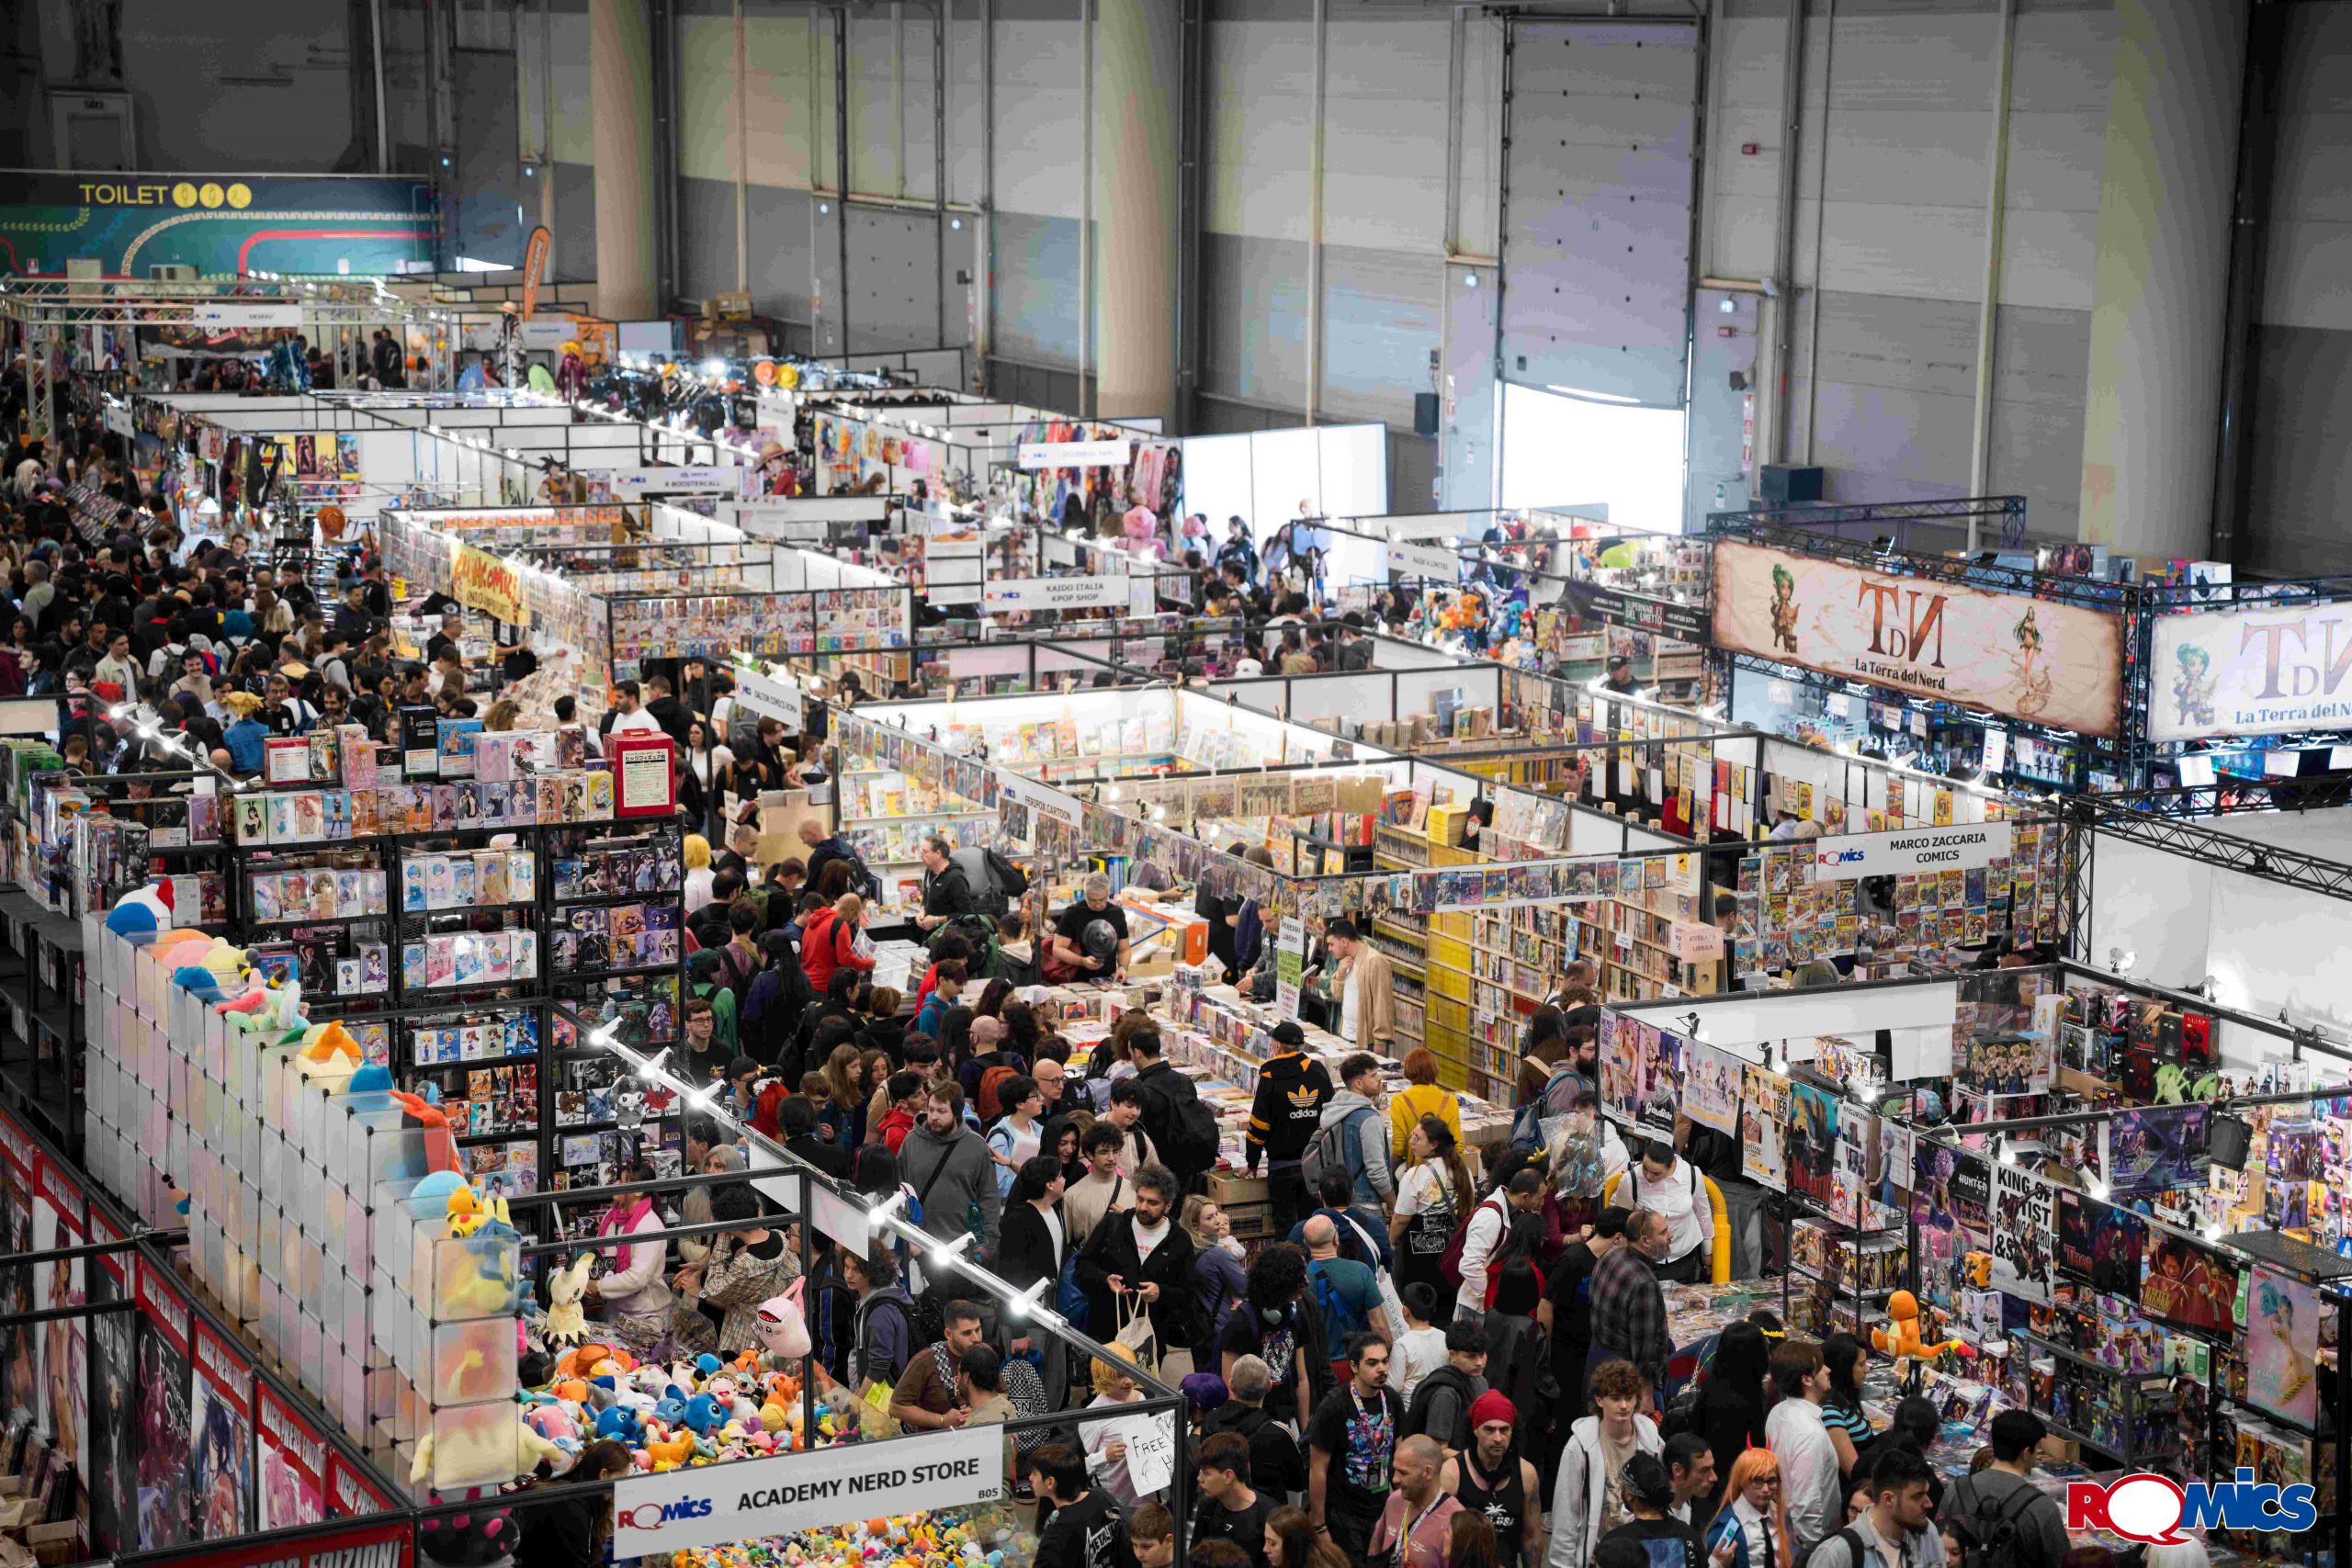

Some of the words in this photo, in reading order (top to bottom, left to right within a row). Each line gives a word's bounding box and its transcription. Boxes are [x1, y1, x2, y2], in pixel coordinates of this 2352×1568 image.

[79, 184, 168, 205] TOILET
[1046, 584, 1073, 592] KAIDO
[1052, 594, 1073, 603] KPOP
[1855, 659, 1867, 672] La
[1869, 661, 1899, 682] Terra
[1901, 670, 1917, 684] del
[1919, 672, 1945, 690] Nerd
[2235, 711, 2255, 724] La
[2258, 708, 2307, 722] Terra
[2312, 703, 2336, 718] del
[1024, 795, 1046, 812] FERIFOX
[1047, 804, 1071, 820] CARTOON
[1890, 838, 1929, 851] MARCO
[1932, 833, 1986, 847] ZACCARIA
[1917, 850, 1960, 863] COMICS
[1819, 919, 1835, 928] THOR
[1689, 933, 1716, 942] ENTRATA
[1289, 1109, 1317, 1119] adidas
[1997, 1167, 2030, 1193] KING
[1132, 1435, 1167, 1459] FREE
[738, 1479, 842, 1511] ACADEMY
[848, 1470, 907, 1494] NERD
[912, 1458, 979, 1484] STORE
[978, 1488, 999, 1499] B05
